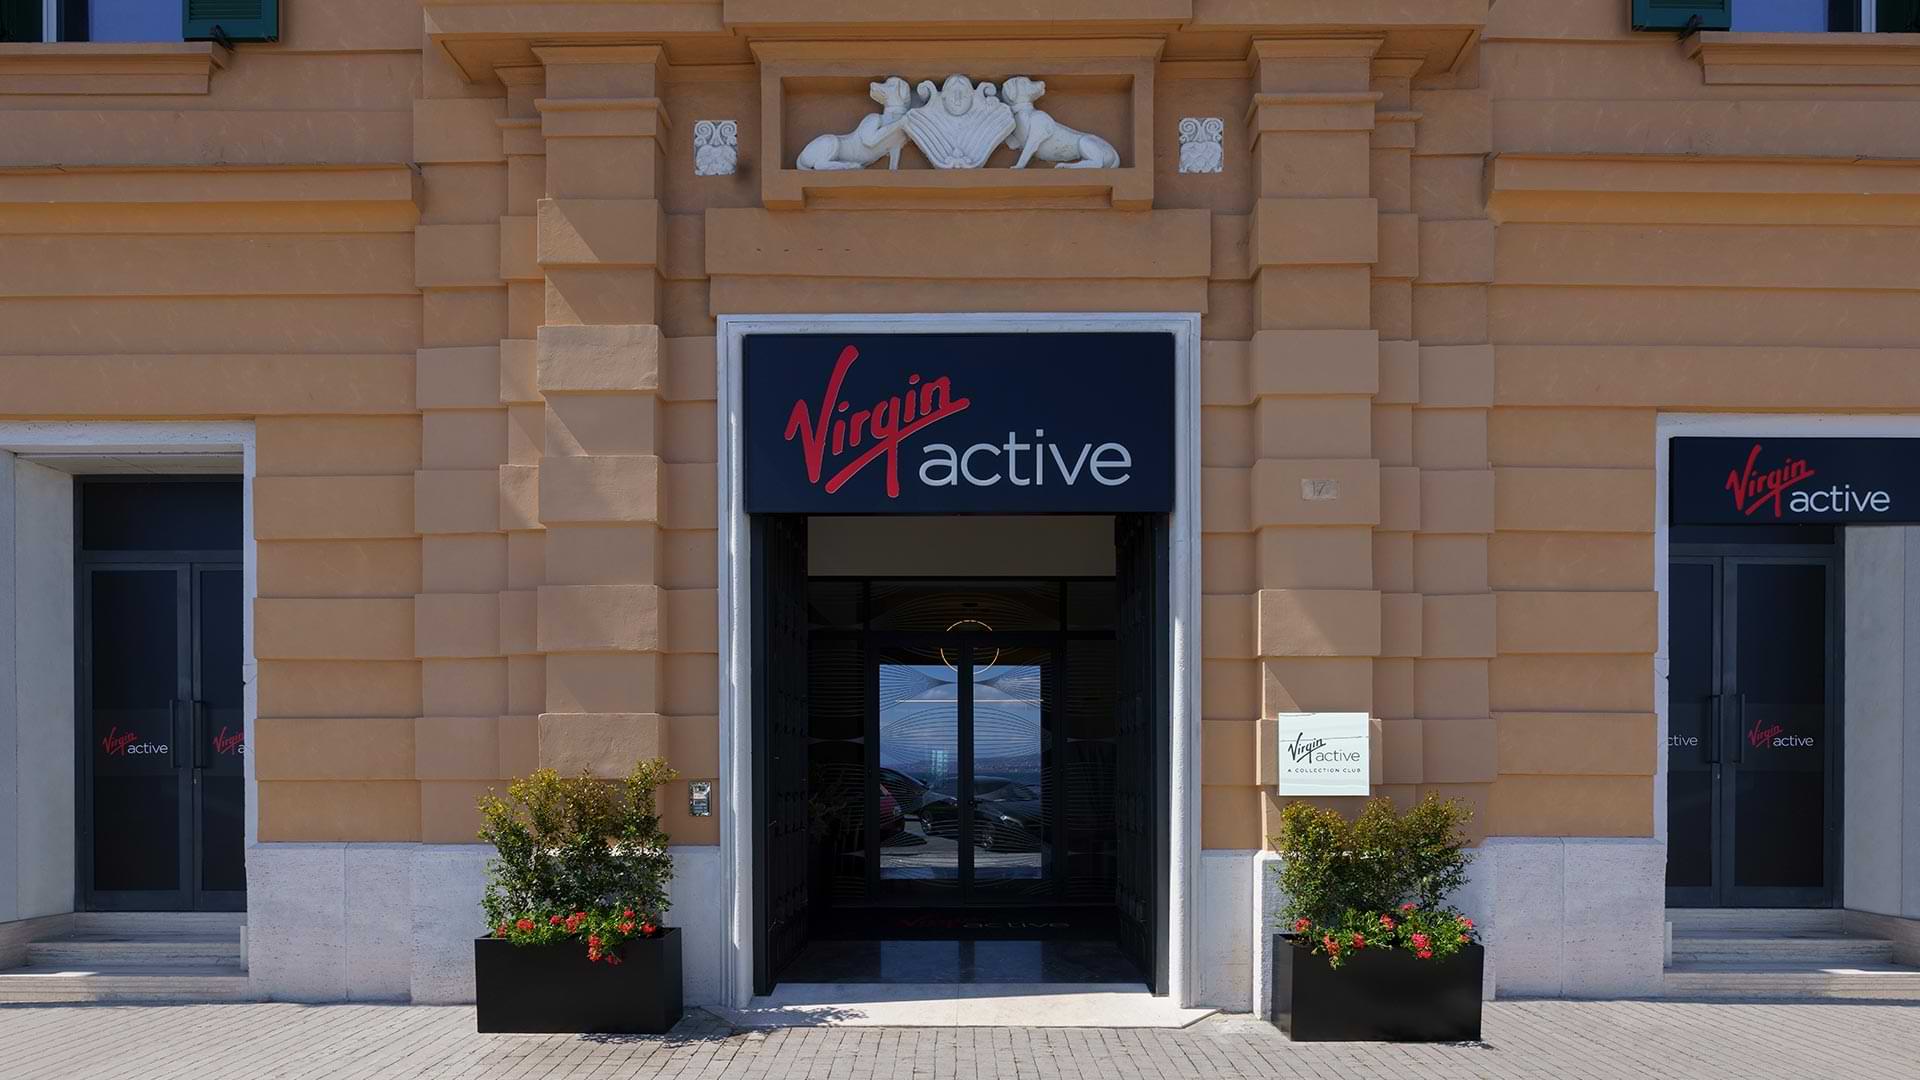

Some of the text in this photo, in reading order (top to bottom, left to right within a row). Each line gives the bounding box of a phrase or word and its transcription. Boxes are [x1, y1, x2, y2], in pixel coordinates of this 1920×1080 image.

[784, 344, 1132, 498] Virgin active
[1725, 443, 1891, 518] Virgin active
[102, 726, 169, 756] Virgin active
[1287, 731, 1361, 764] Virgin active
[1748, 719, 1814, 749] Virgin active
